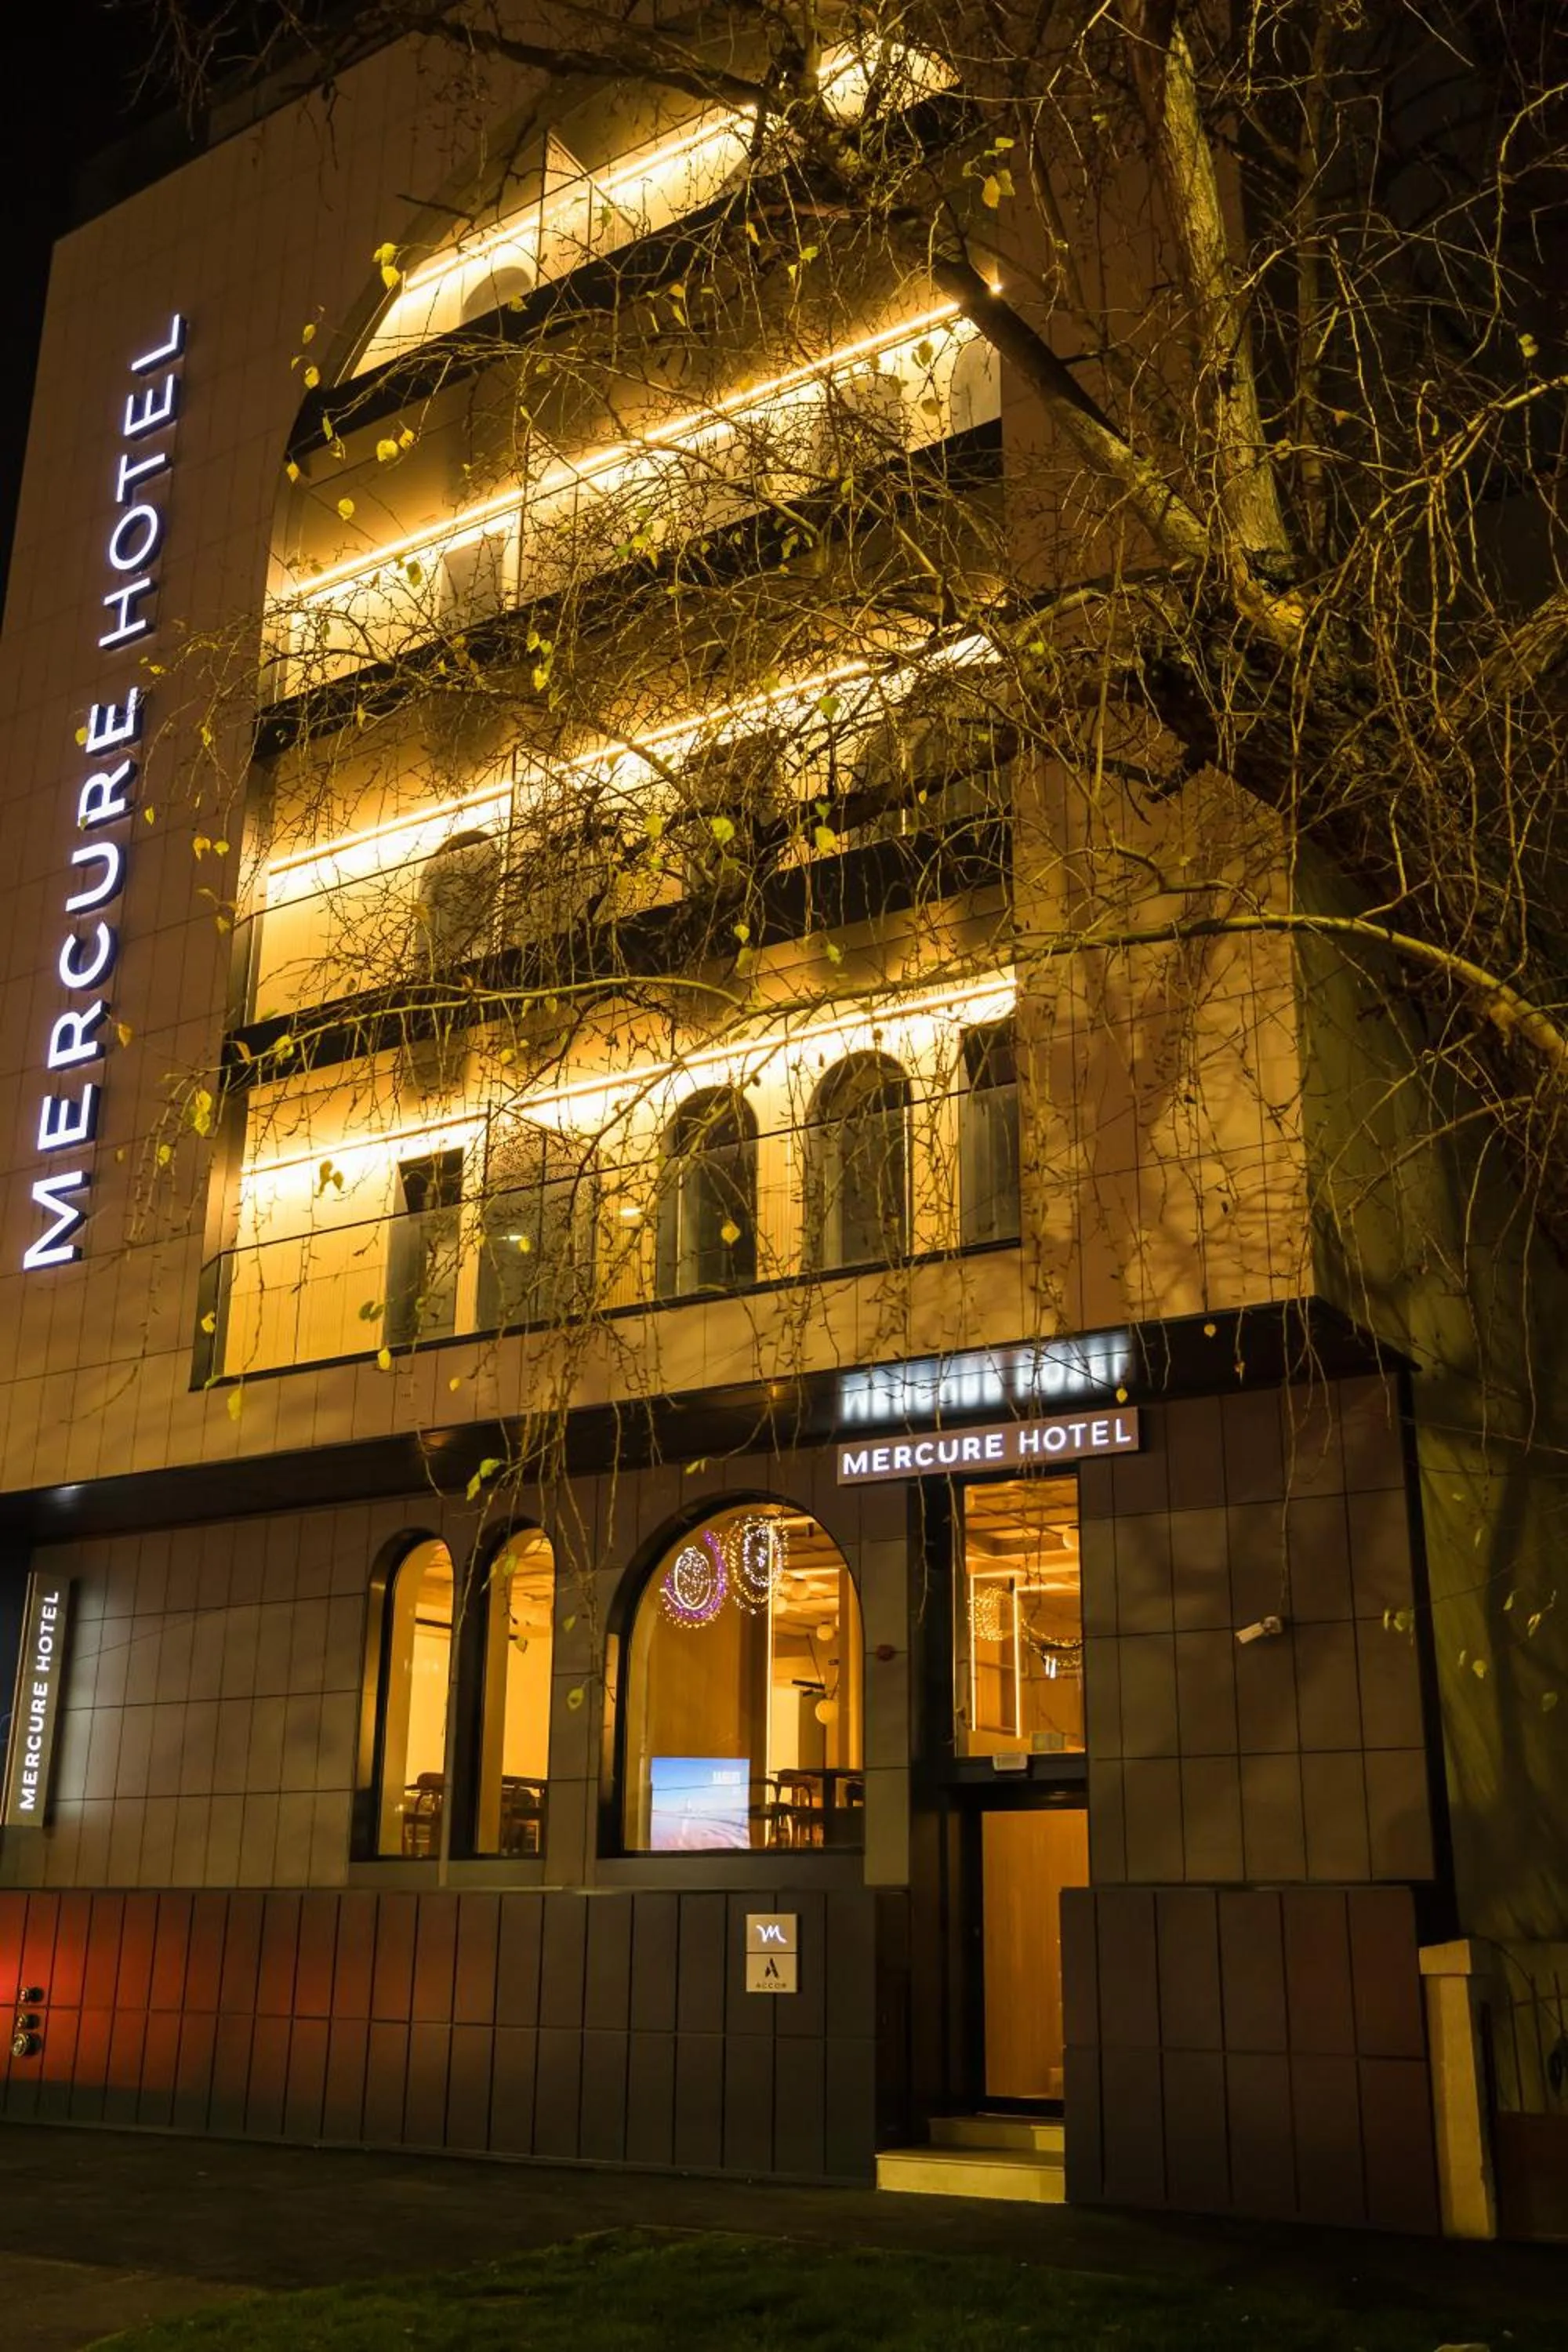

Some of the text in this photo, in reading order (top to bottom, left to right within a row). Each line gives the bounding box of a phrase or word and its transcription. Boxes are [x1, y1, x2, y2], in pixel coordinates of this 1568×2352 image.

[23, 314, 180, 1270] MERCURE HOTEL
[843, 1418, 1132, 1475] MERCURE HOTEL
[20, 1592, 59, 1811] MERCURE HOTEL
